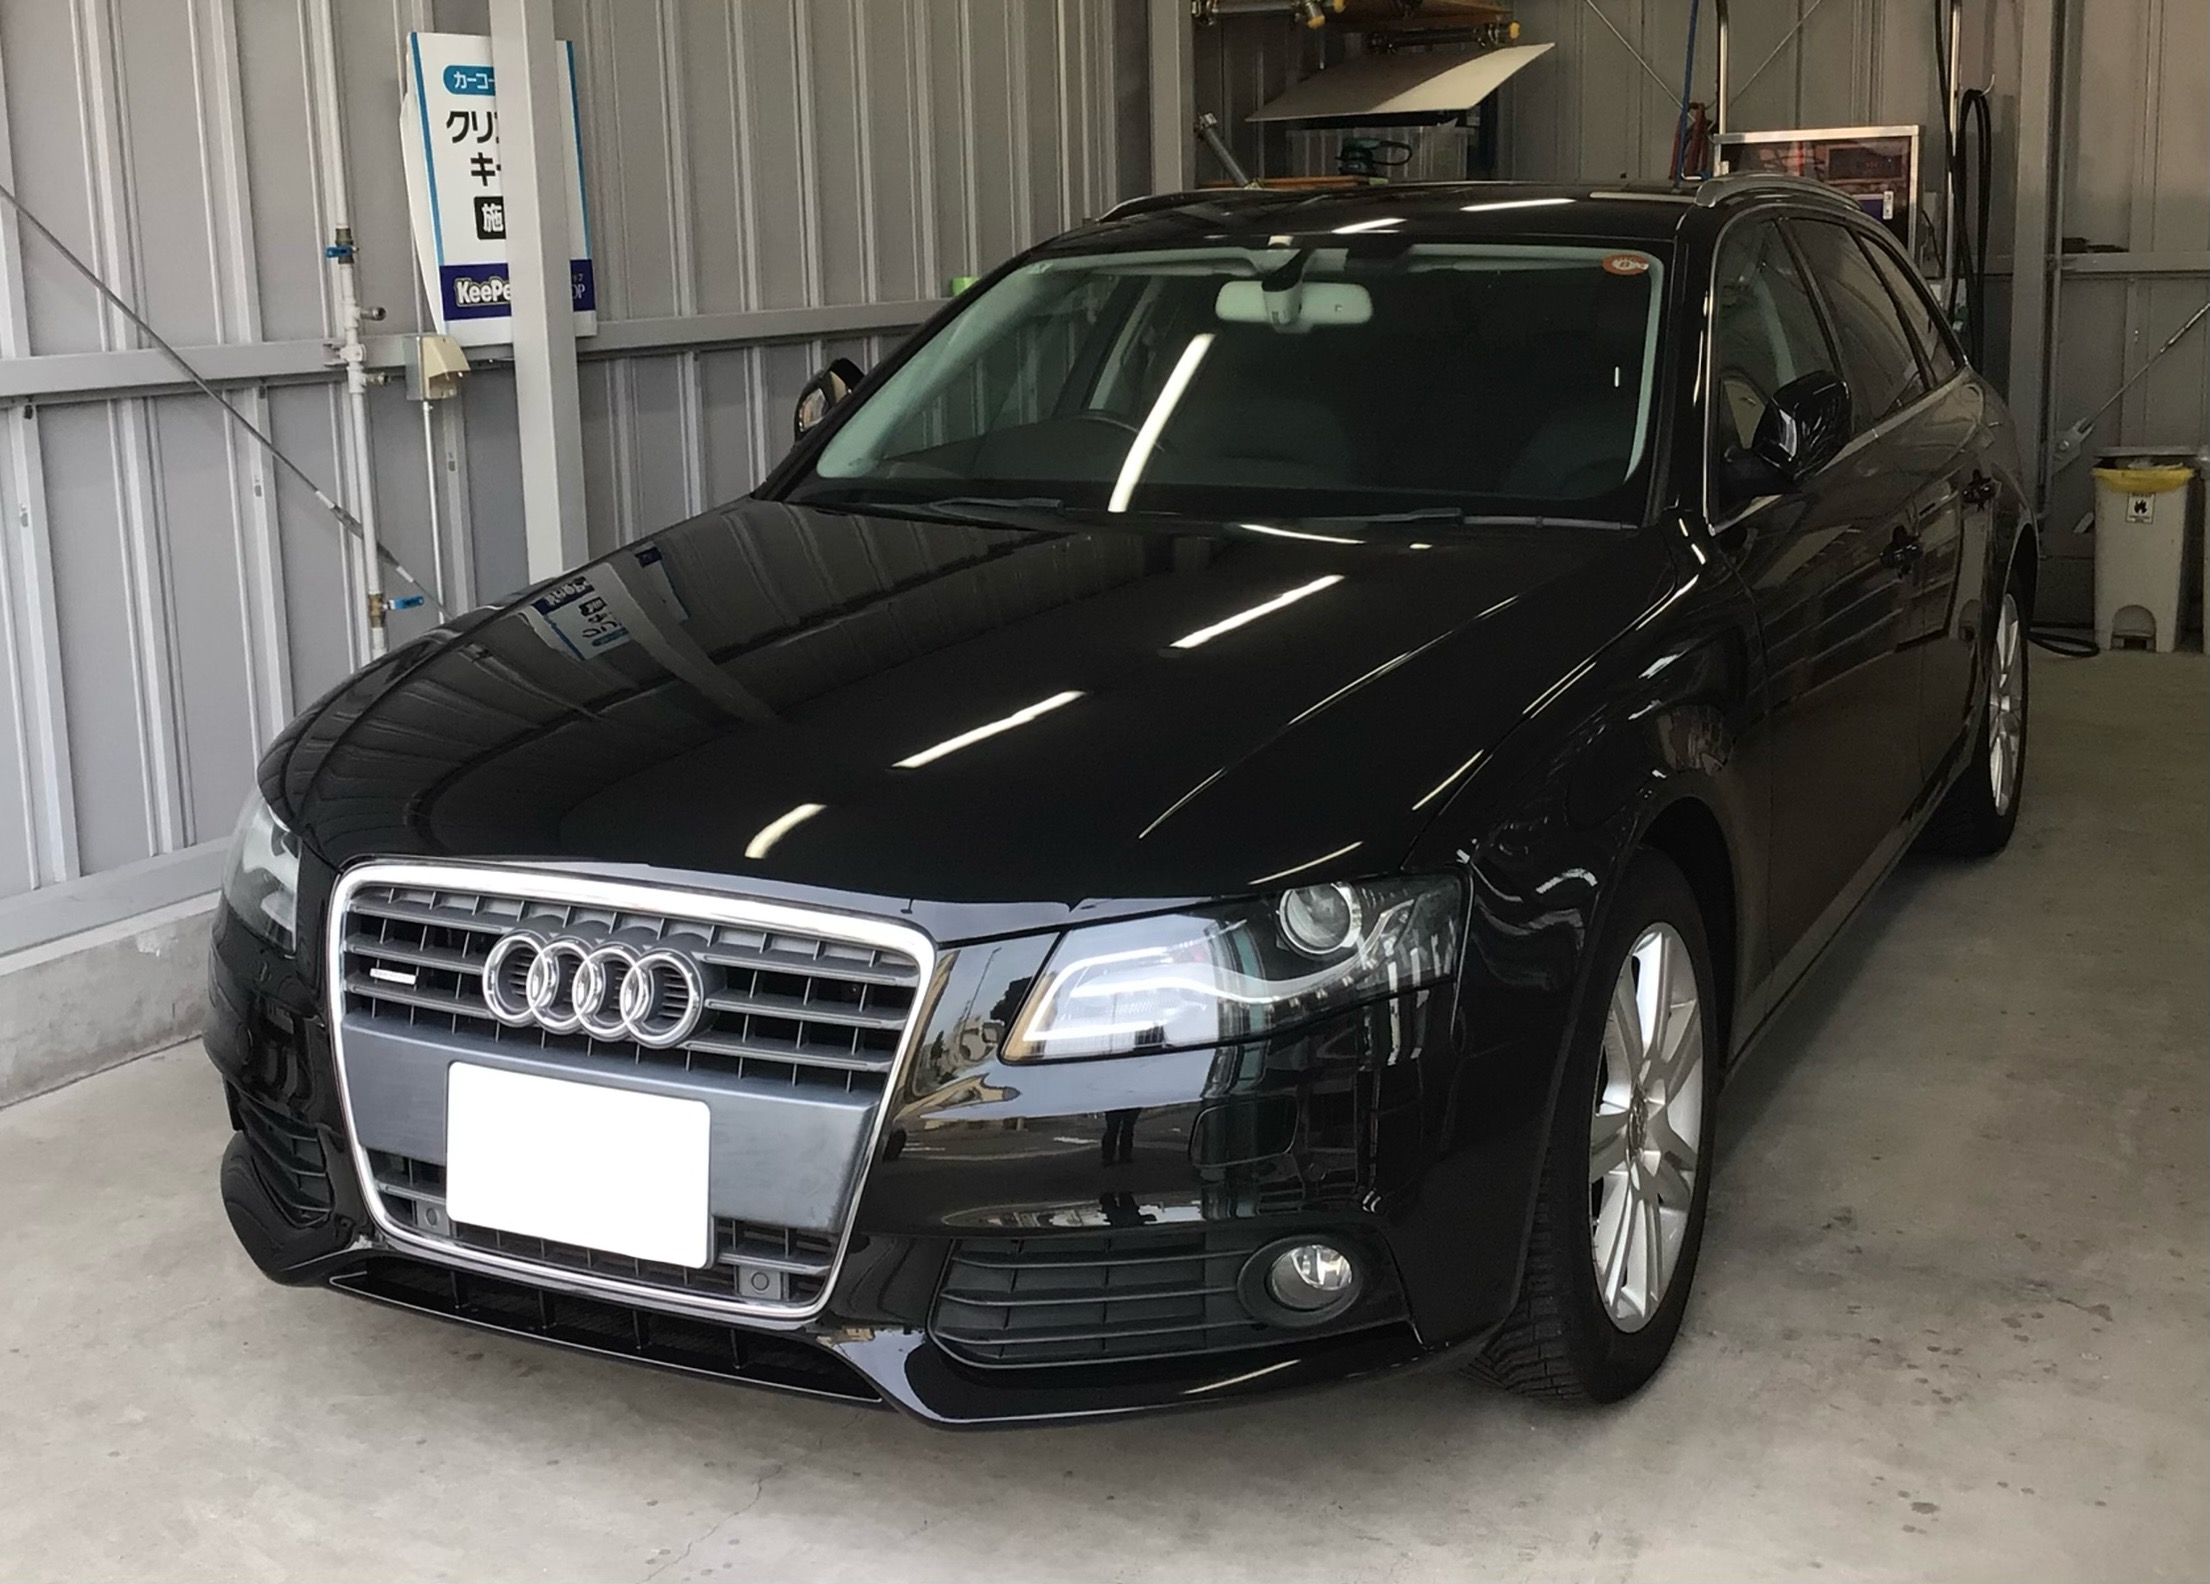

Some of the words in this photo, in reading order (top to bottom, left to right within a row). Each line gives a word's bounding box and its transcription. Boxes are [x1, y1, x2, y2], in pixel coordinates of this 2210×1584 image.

[446, 111, 499, 144] クリ
[470, 152, 501, 187] キ
[481, 203, 503, 232] 施
